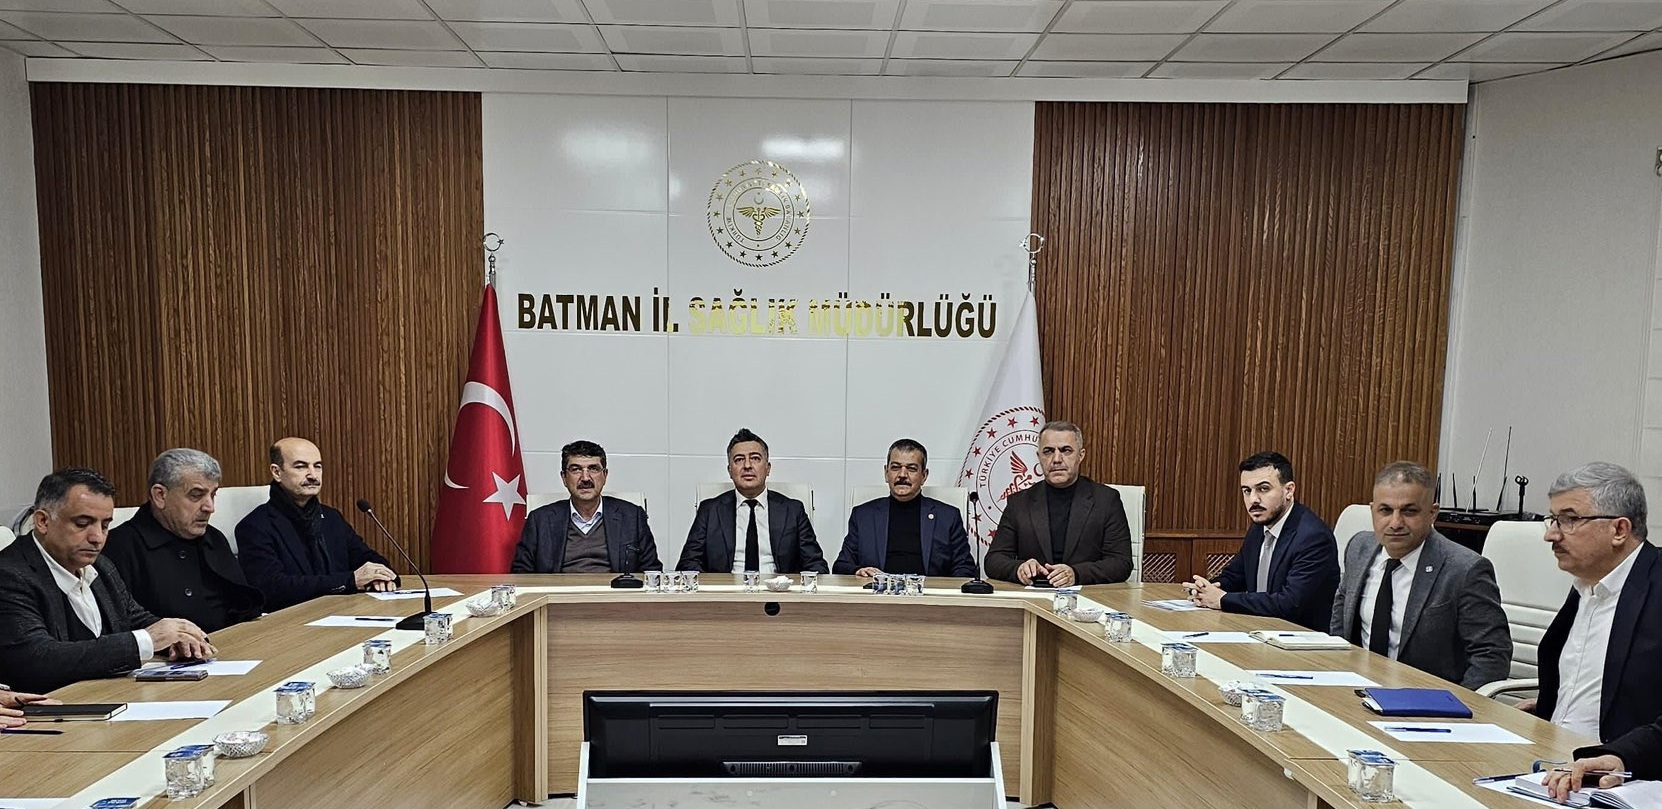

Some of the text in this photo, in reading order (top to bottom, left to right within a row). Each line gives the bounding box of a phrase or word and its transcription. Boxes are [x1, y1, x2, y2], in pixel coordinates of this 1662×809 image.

[517, 287, 997, 339] BATMAN İL SAĞLIK MÜDÜRLÜĞÜ
[979, 434, 1038, 488] TÜRKİYE CUMHU
